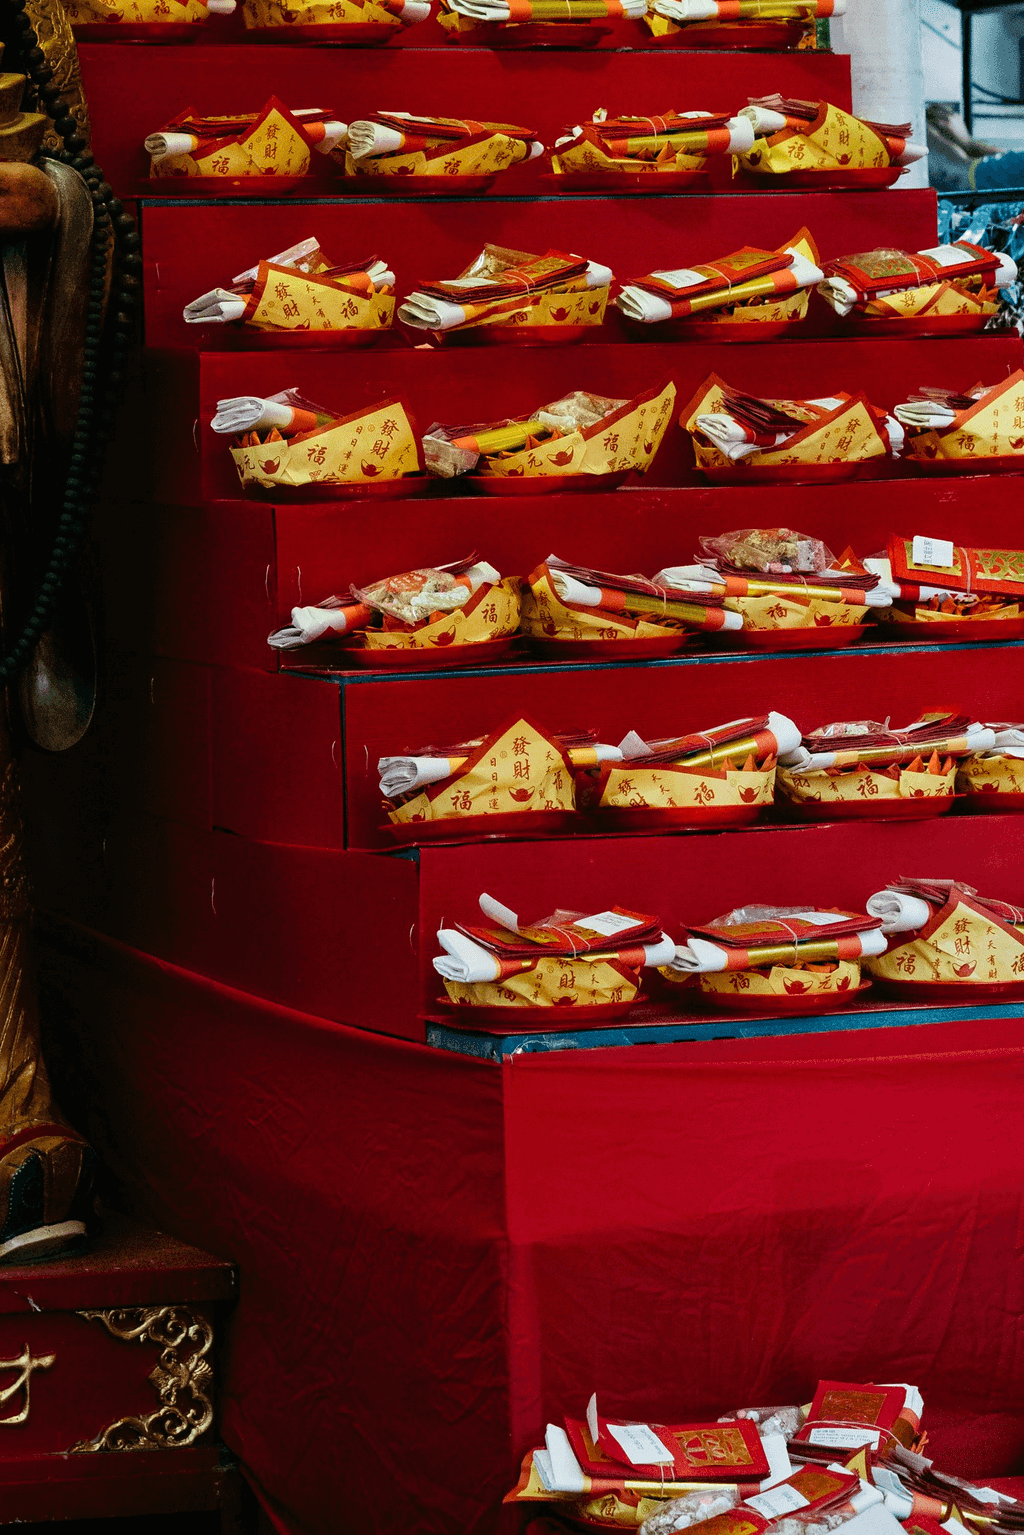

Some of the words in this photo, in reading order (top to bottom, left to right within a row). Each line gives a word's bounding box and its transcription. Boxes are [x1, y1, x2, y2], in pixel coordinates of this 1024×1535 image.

[327, 1, 346, 19] 福
[263, 124, 280, 159] 發財
[787, 141, 806, 161] 福
[211, 155, 230, 175] 福
[443, 157, 462, 175] 福
[274, 282, 300, 321] 發財
[341, 297, 359, 319] 福
[370, 419, 400, 460] 發財
[603, 431, 618, 453] 福
[835, 418, 861, 452] 發財
[956, 434, 975, 452] 福
[307, 444, 328, 465] 福
[527, 453, 543, 468] 元
[481, 603, 498, 623] 福
[766, 602, 788, 621] 福
[511, 735, 531, 780] 發財
[488, 757, 500, 810] 日日幸運
[693, 781, 715, 806] 福
[857, 775, 879, 798] 福
[450, 789, 473, 811] 福
[952, 917, 973, 956] 發財
[896, 952, 916, 975] 福
[986, 925, 998, 980] 天天有財
